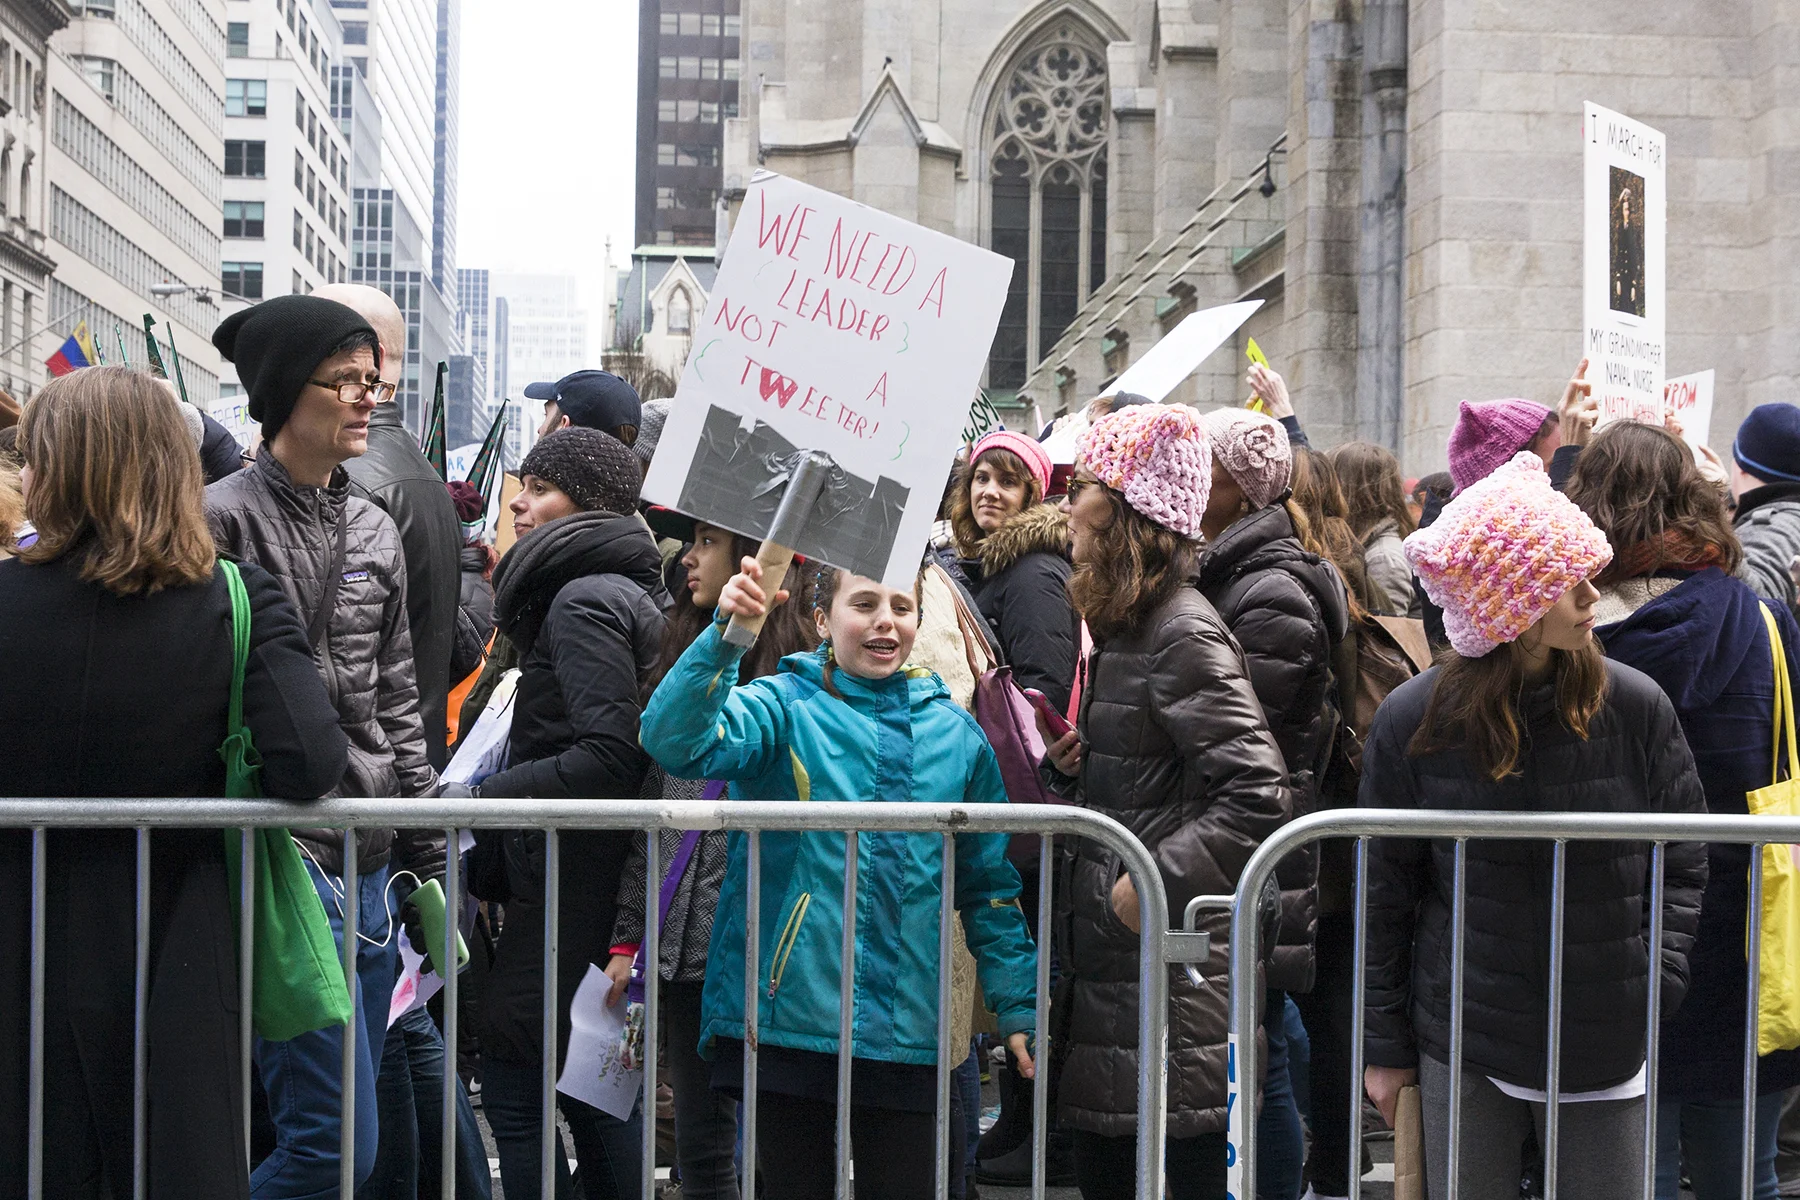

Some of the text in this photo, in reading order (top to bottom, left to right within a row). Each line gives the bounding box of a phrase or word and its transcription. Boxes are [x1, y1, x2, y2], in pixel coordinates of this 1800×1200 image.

[1591, 113, 1662, 170] I MARCH FOR
[759, 188, 947, 318] WE NEED A
[777, 269, 890, 341] LEADER
[714, 298, 887, 407] NOT A
[1590, 328, 1662, 366] MY GRANDMOTHER
[1605, 361, 1653, 394] NAVAL NURSE
[740, 355, 879, 439] TWEETER!
